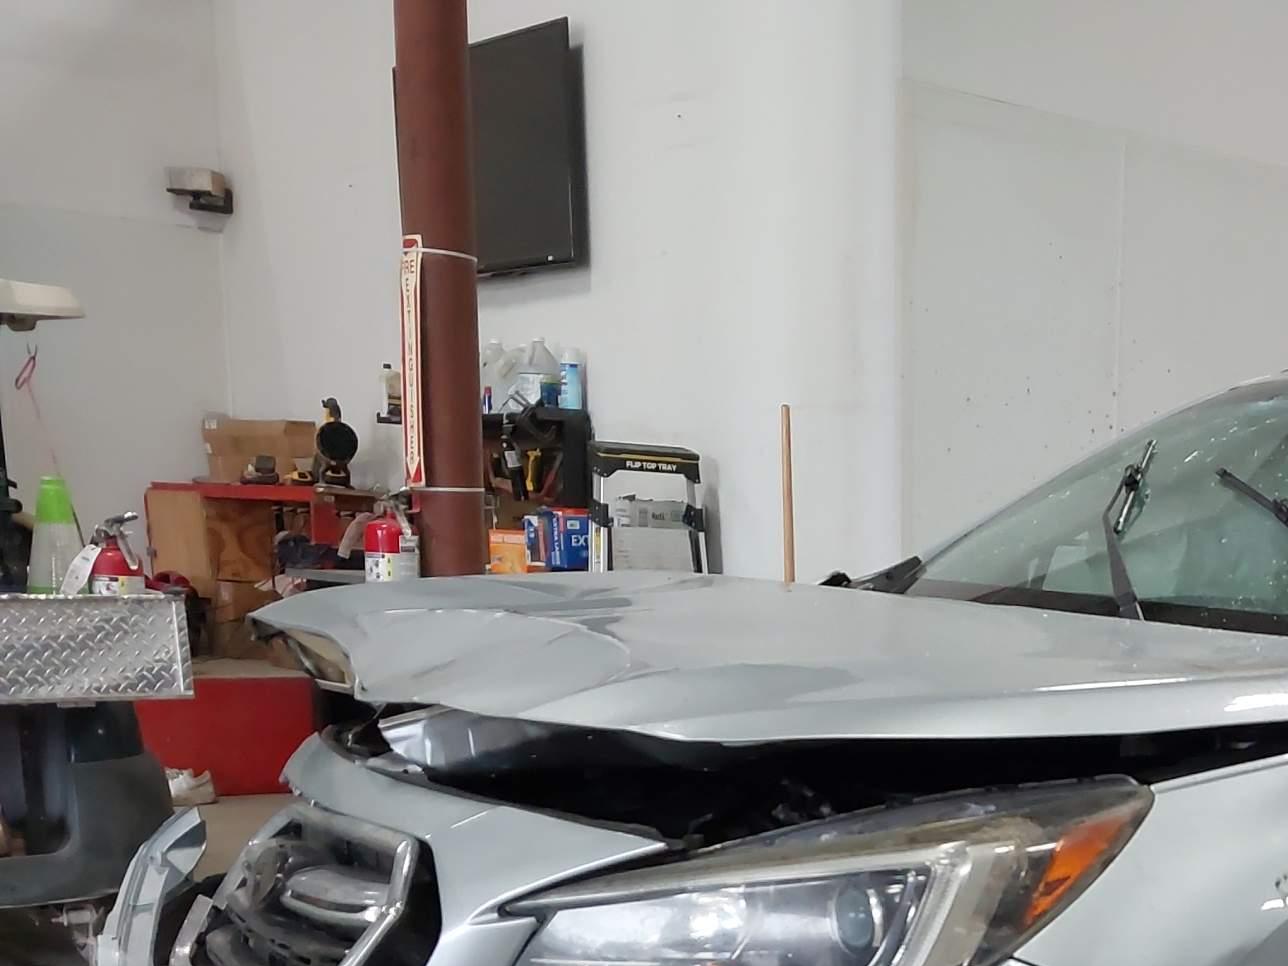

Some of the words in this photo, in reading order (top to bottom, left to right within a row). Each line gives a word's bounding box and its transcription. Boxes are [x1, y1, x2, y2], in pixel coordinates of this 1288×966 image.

[625, 460, 642, 469] FLIP
[643, 461, 657, 470] TOP
[658, 463, 677, 472] TRAY
